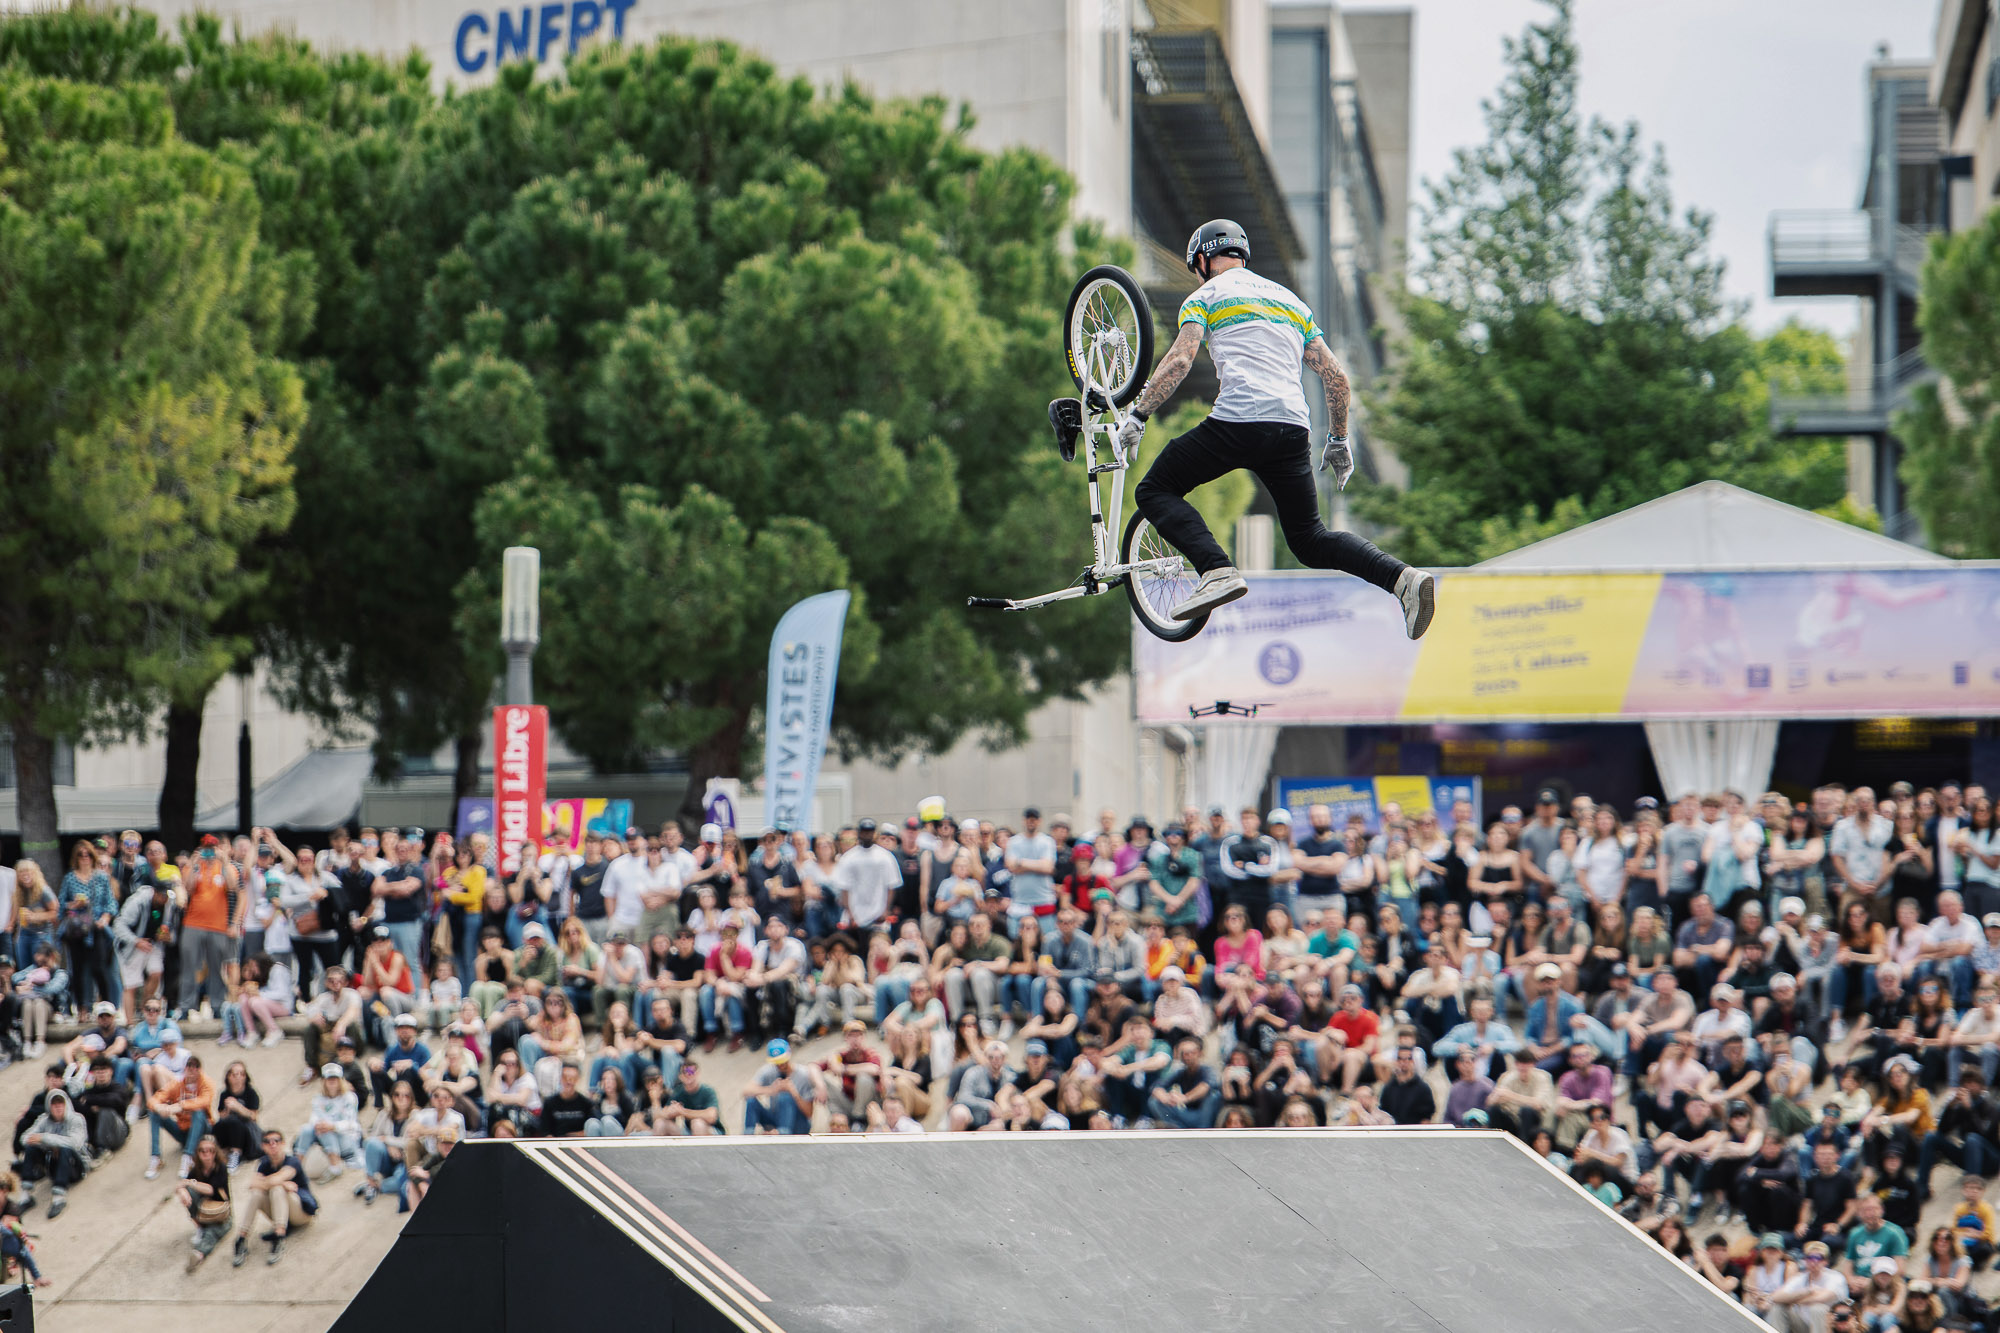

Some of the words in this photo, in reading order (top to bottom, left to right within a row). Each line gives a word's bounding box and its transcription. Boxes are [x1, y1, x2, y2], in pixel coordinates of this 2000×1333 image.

[455, 0, 637, 72] CNFPT
[1202, 239, 1218, 251] FIST
[502, 707, 530, 793] Libre
